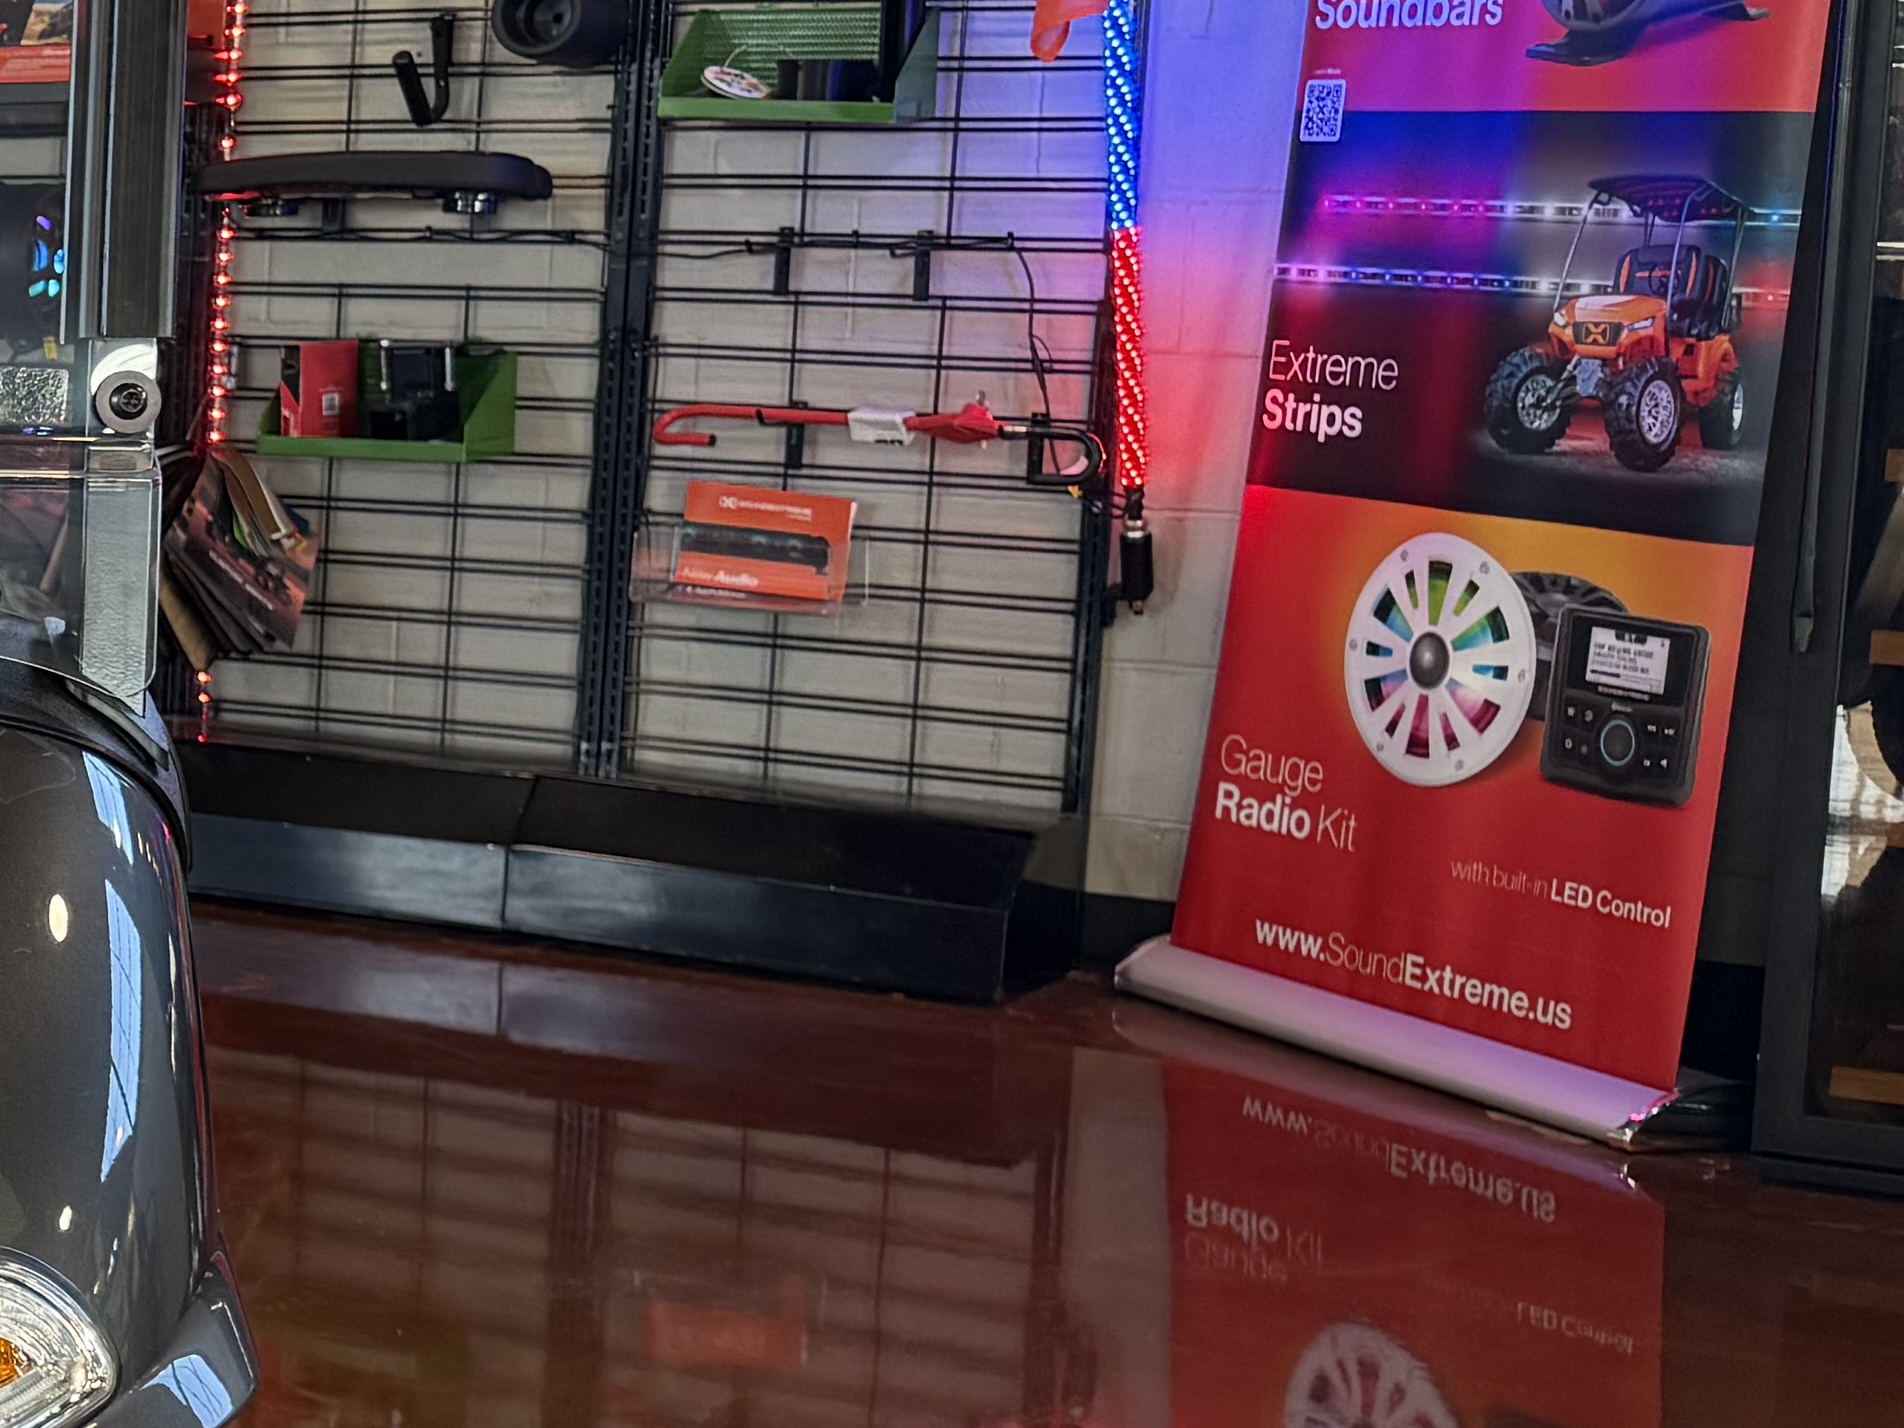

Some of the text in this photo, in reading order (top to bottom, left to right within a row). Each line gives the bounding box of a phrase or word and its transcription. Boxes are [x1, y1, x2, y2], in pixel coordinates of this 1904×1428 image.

[1269, 339, 1399, 390] Extreme
[1262, 388, 1363, 443] Strips
[1221, 734, 1323, 796] Gauge
[1215, 781, 1357, 852] Radio Kit
[1450, 860, 1672, 928] with built-in LED Control
[1255, 919, 1572, 1030] www.SoundExtreme.us
